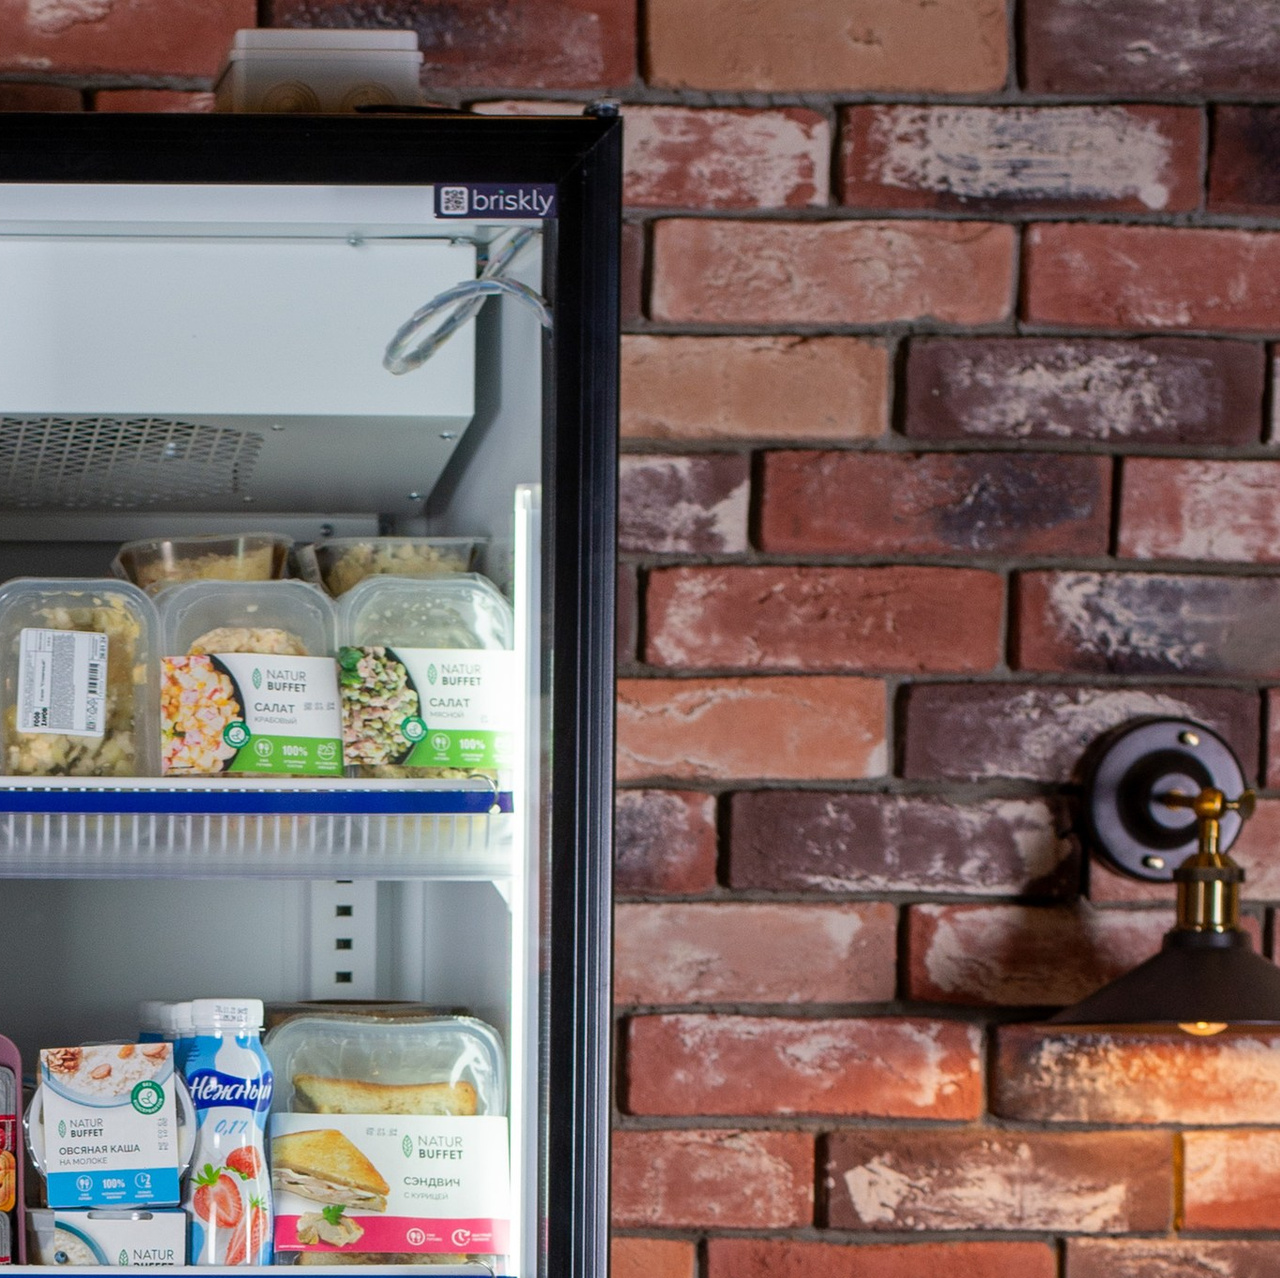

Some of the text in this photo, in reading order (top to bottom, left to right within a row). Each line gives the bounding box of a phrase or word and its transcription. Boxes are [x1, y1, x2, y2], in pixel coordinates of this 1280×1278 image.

[472, 187, 554, 216] briskly
[441, 664, 481, 675] NATUR
[266, 670, 306, 681] NATUR
[442, 676, 482, 686] BUFFET
[267, 682, 307, 693] BUFFET
[254, 702, 295, 713] САЛАТ
[429, 698, 470, 708] САЛАТ
[282, 745, 308, 757] 100%
[189, 1076, 273, 1101] Нежный
[70, 1118, 104, 1128] NATUR
[70, 1128, 104, 1138] BUFFET
[417, 1135, 463, 1148] NATUR
[59, 1144, 141, 1156] ОВСЯНАЯ КАША
[418, 1149, 464, 1160] BUFFET
[59, 1157, 108, 1166] НА МОЛОКЕ
[403, 1176, 461, 1188] СЭНДВИЧ
[404, 1191, 449, 1200] С КУРИЦЕЙ
[133, 1249, 174, 1261] NATUR
